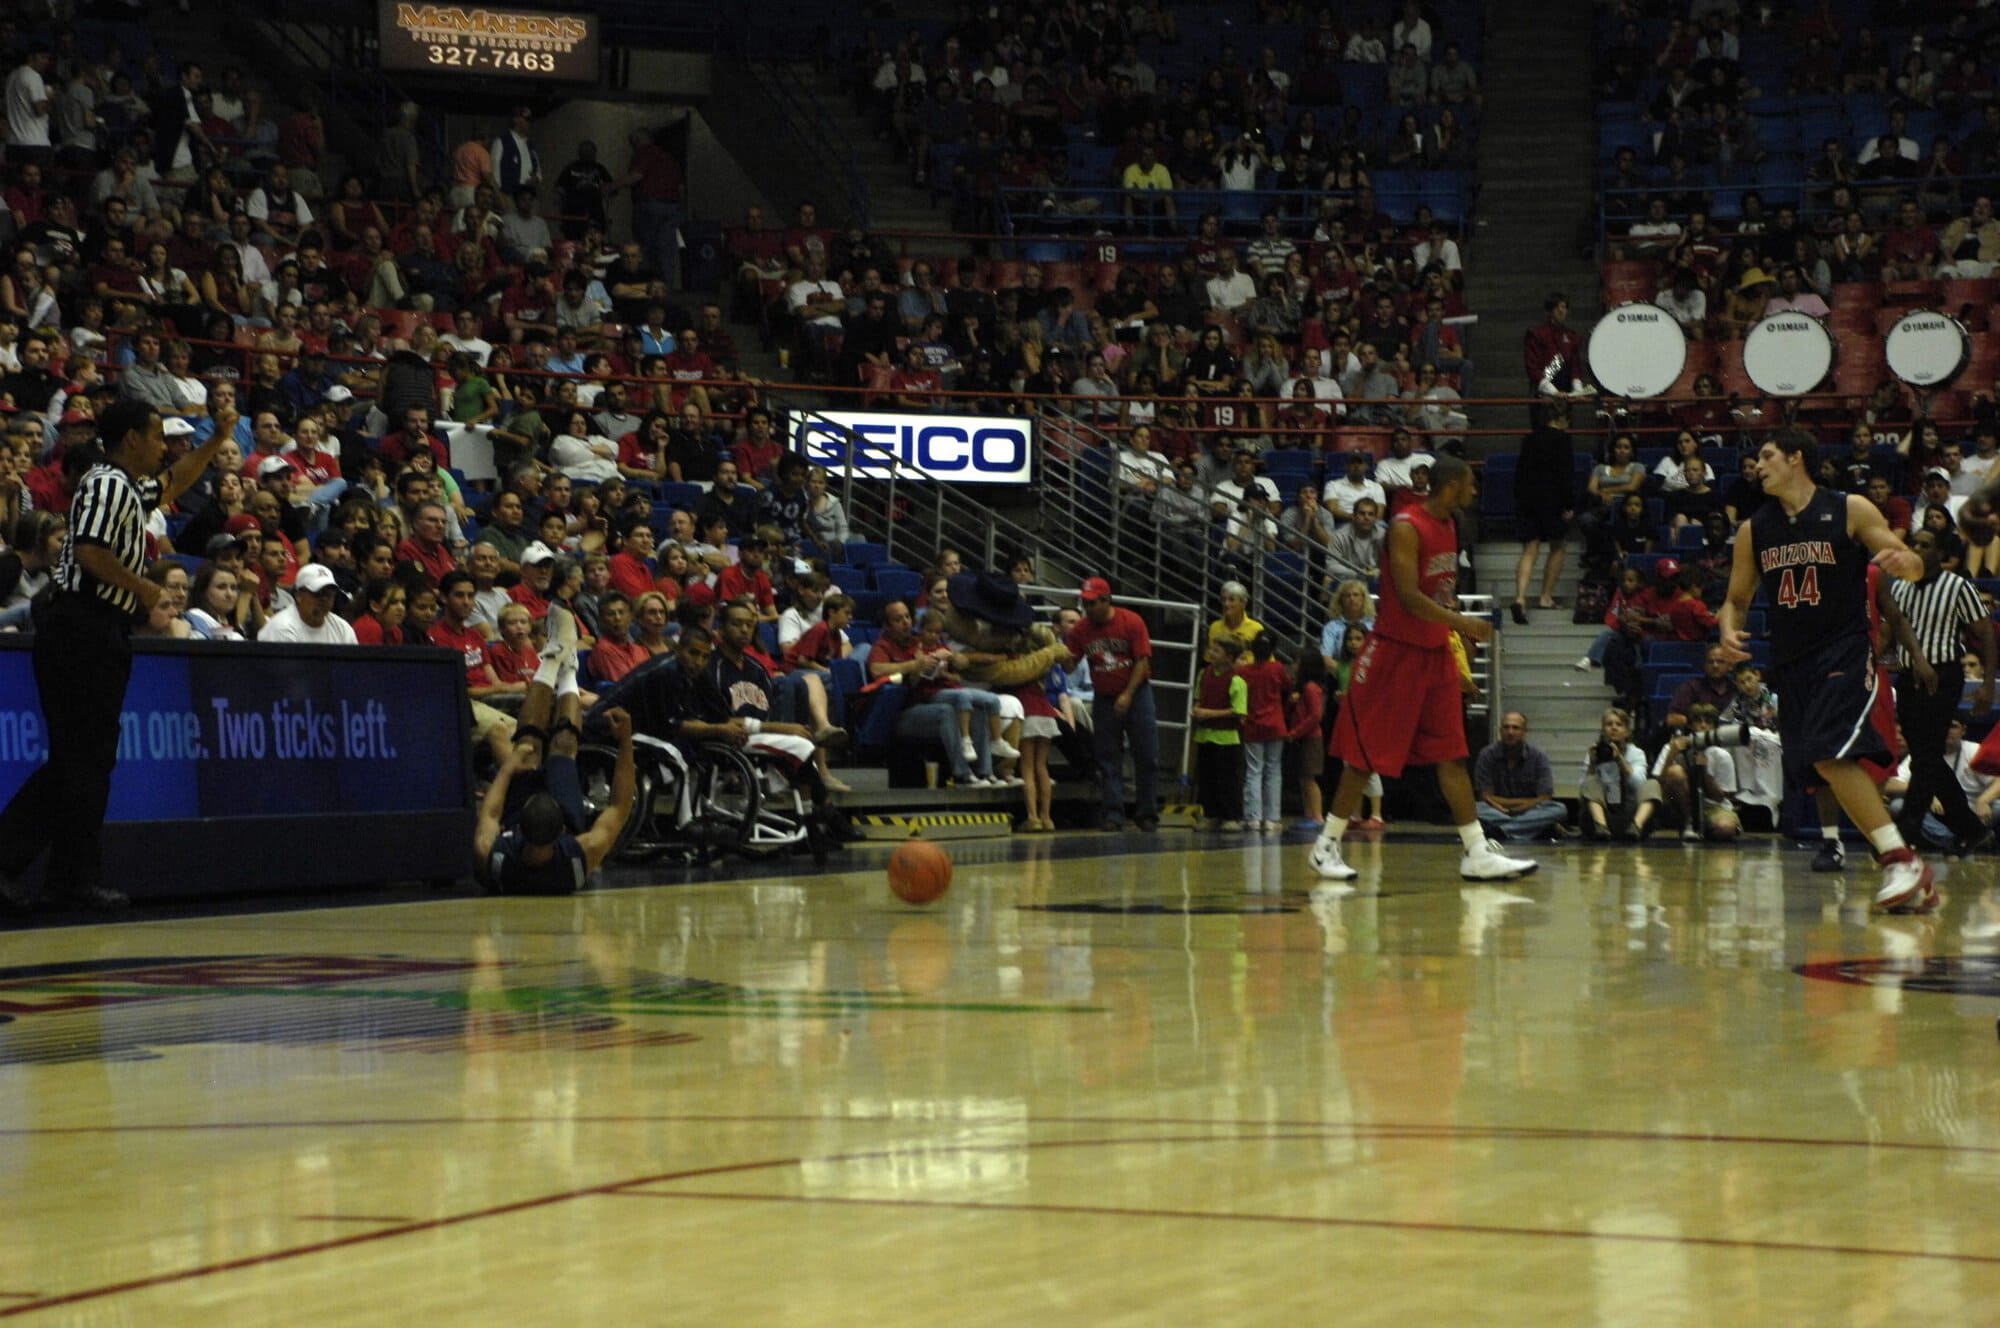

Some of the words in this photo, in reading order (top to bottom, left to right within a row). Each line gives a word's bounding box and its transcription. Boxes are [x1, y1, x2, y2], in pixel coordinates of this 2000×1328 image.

[411, 32, 459, 45] PRIME
[469, 35, 573, 53] STEAKHOUSE
[428, 45, 556, 72] 327-7463
[1098, 245, 1117, 263] 19
[1626, 312, 1659, 323] YAMAHA
[1776, 321, 1809, 332] YAMAHA
[1911, 320, 1946, 332] YAMAHA
[1214, 406, 1235, 426] 19
[795, 422, 1026, 473] GEICO
[1761, 541, 1837, 573] ARIZONA
[1777, 565, 1821, 608] 44
[147, 710, 209, 760] one.
[212, 698, 265, 760] Two
[272, 700, 336, 760] ticks
[341, 699, 398, 759] left.
